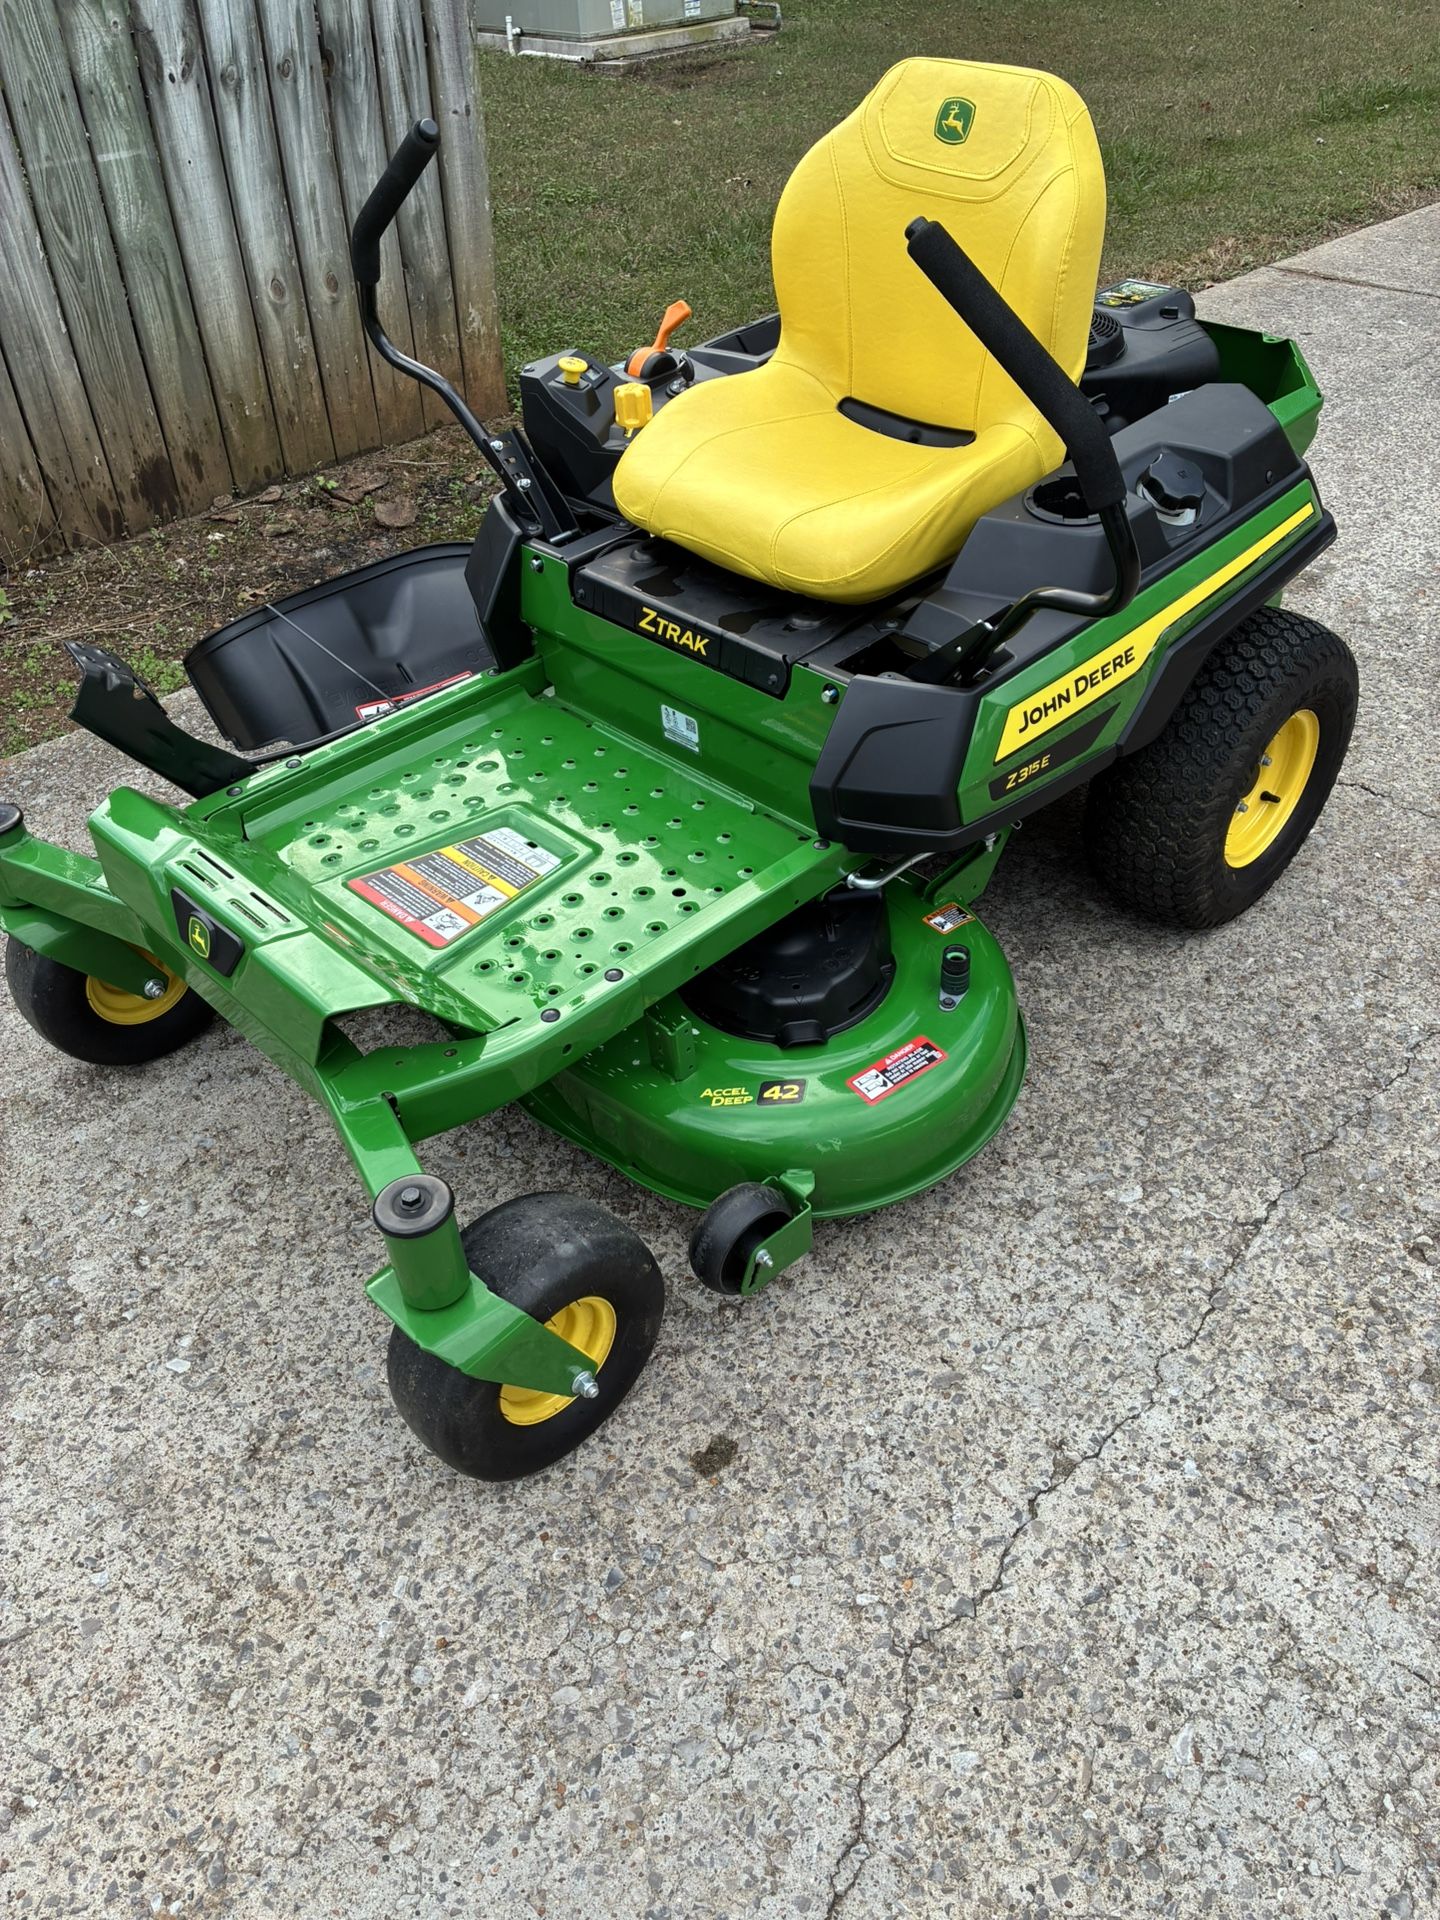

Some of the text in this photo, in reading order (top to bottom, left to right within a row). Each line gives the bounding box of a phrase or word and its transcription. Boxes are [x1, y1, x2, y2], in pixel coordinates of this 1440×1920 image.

[638, 606, 710, 656] ZTRAK
[1018, 646, 1135, 734] JOHN DEERE
[700, 1087, 750, 1098] ACCEL
[762, 1084, 800, 1100] 42
[711, 1095, 754, 1107] DEEP
